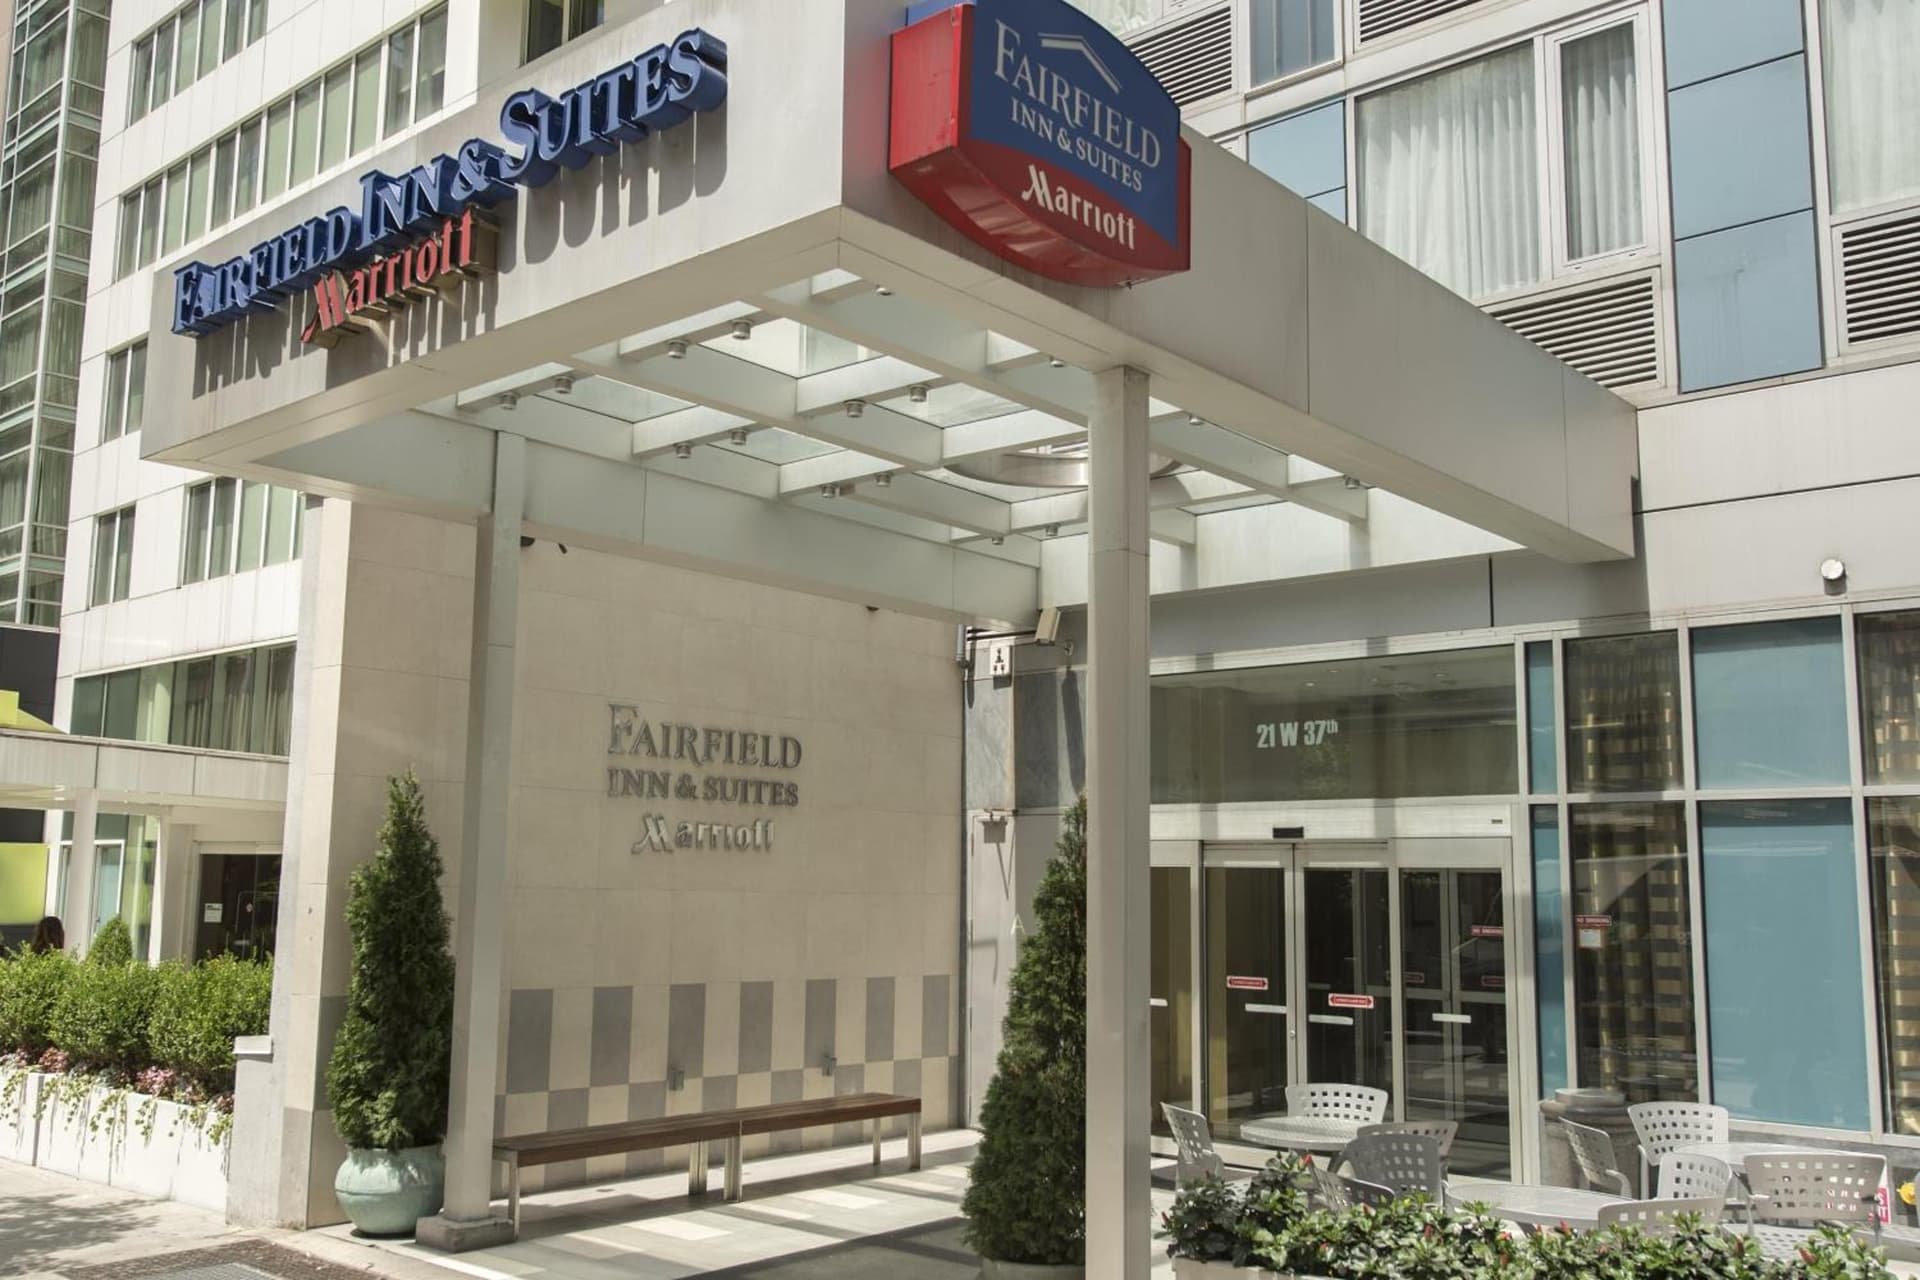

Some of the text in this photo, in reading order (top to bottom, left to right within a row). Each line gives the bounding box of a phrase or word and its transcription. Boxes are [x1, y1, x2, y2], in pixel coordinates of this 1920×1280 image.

[994, 19, 1161, 168] FAIRFIELD
[171, 27, 716, 336] FAIRFIELD INN & SUITES
[1010, 97, 1143, 193] INN & SUITES
[1021, 164, 1136, 250] Marriott
[300, 207, 473, 344] Marriott
[607, 703, 802, 769] FAIRFIELD
[1256, 719, 1339, 748] 21 W 37th
[607, 766, 800, 808] INN & SUITES
[630, 813, 776, 855] Marriott
